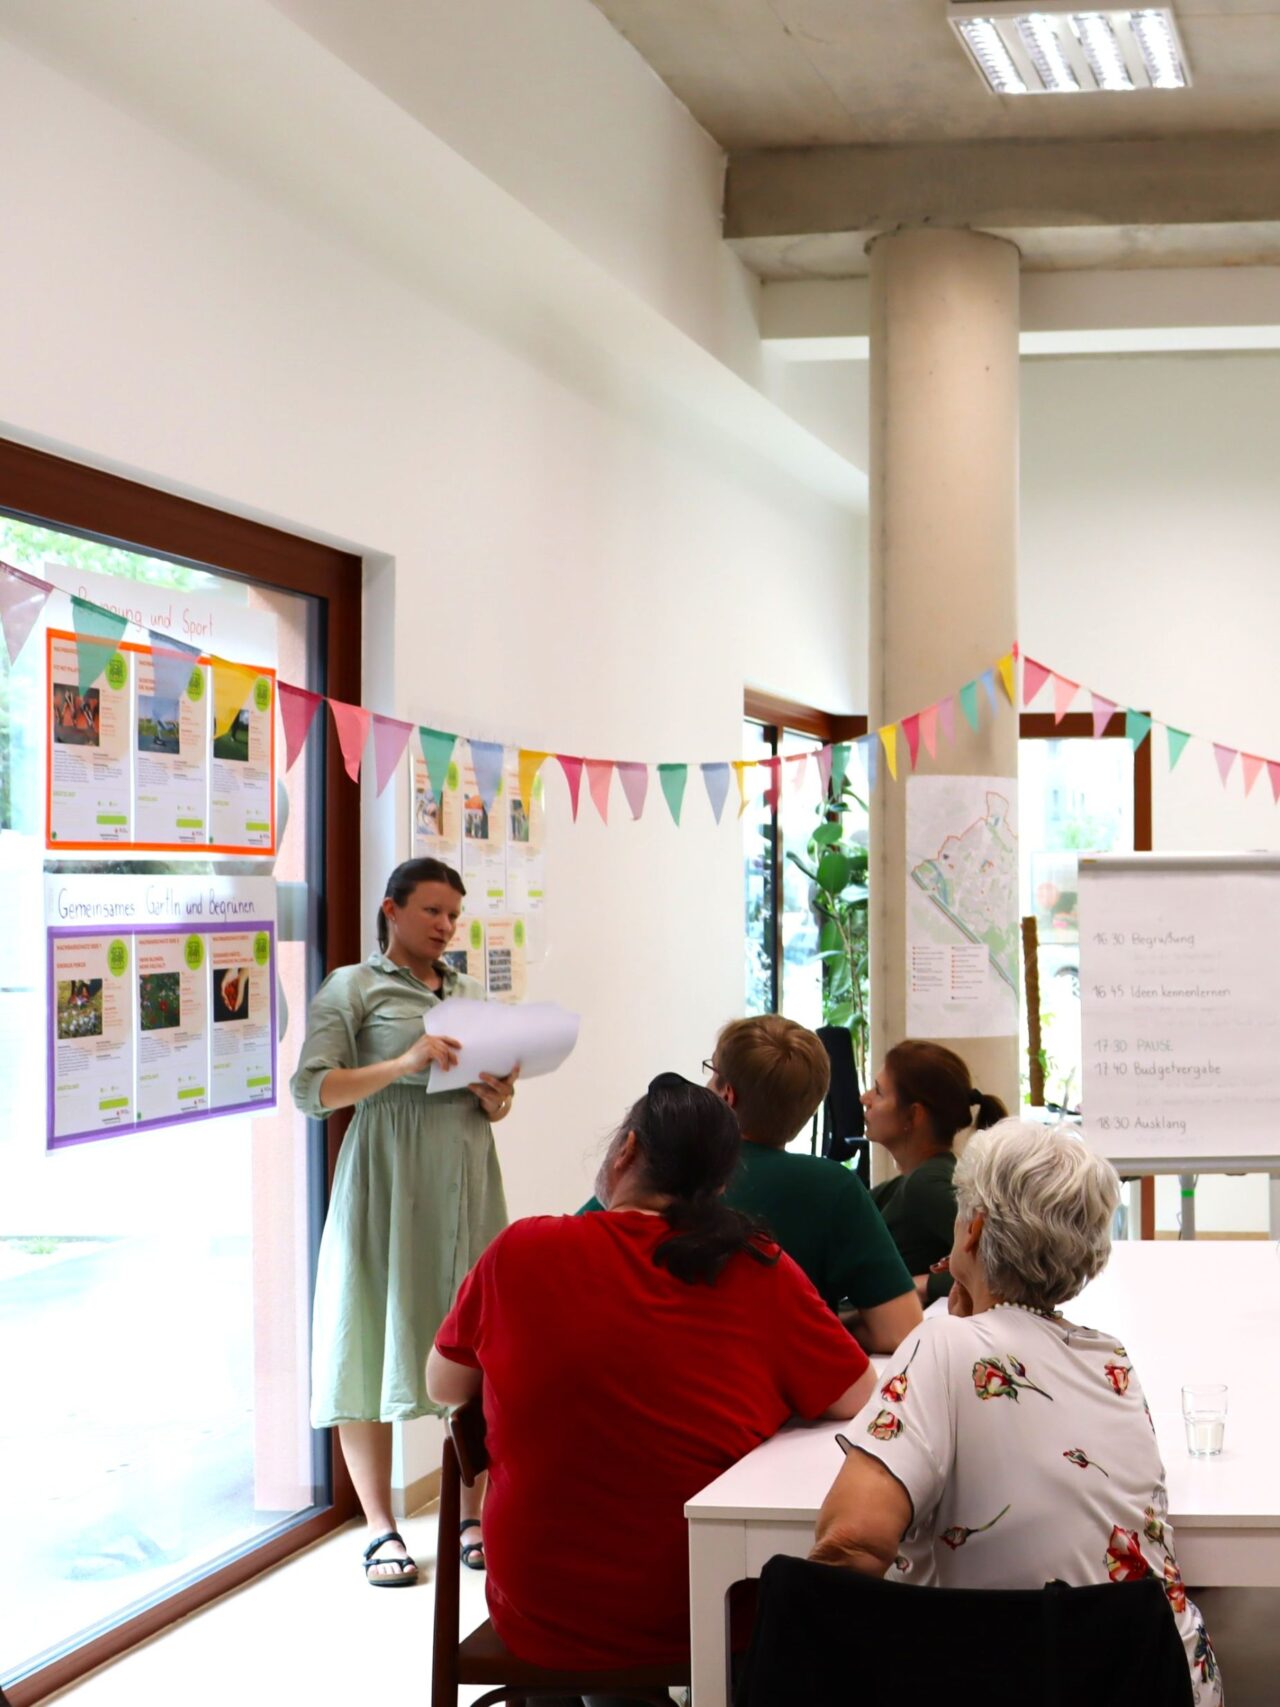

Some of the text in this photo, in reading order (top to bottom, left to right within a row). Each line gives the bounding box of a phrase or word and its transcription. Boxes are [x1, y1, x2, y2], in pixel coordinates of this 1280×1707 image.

[150, 604, 172, 629] und
[182, 607, 213, 641] Sport
[57, 887, 136, 920] Gemeinsames
[185, 892, 203, 916] und
[1130, 984, 1158, 998] Ideen
[1161, 984, 1231, 998] kennenlernen
[1136, 1038, 1174, 1053] PAUSE
[1133, 1059, 1222, 1081] Budgetvergabe
[1134, 1115, 1187, 1135] Ausklang
